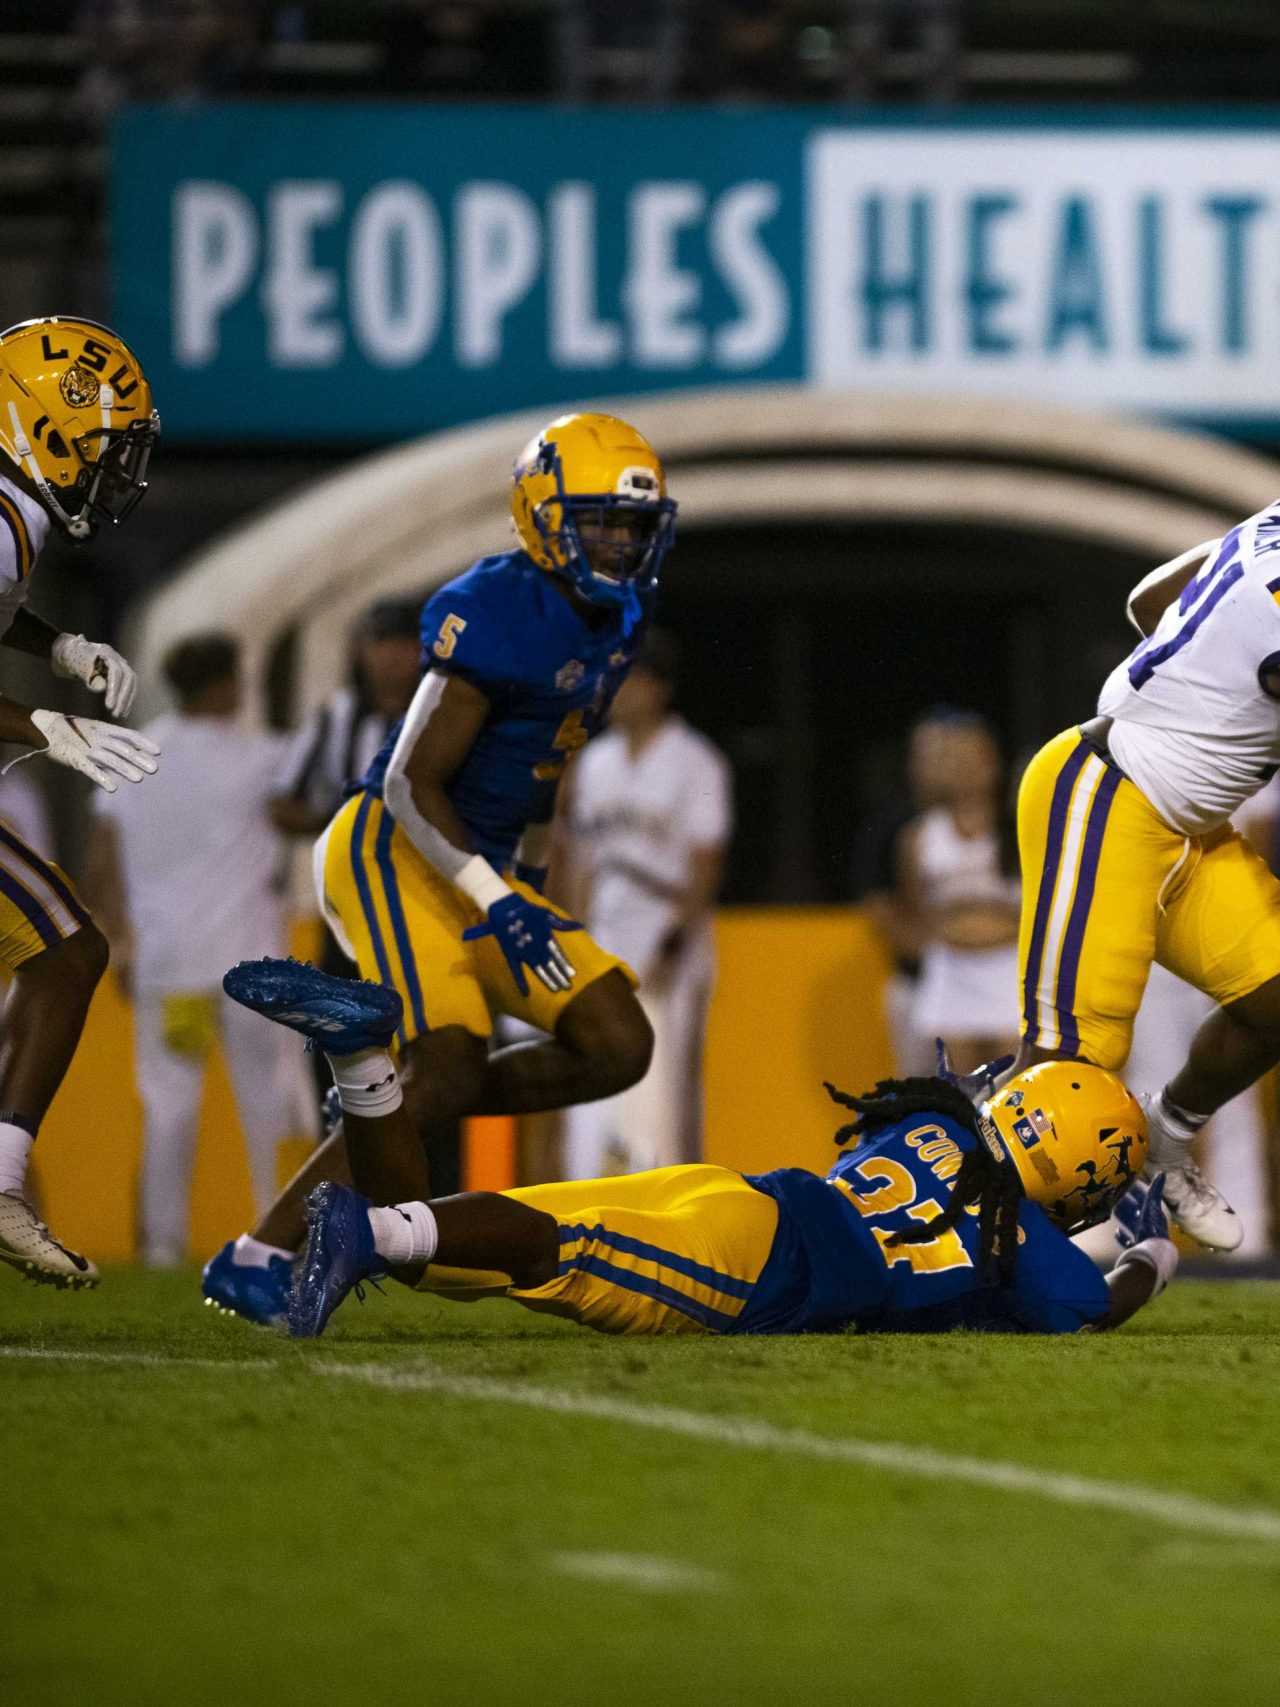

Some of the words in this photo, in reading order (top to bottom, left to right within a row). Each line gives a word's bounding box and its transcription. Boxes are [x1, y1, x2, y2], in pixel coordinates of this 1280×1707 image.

[171, 179, 791, 368] PEOPLES
[41, 335, 138, 399] LSU
[432, 612, 468, 660] 5
